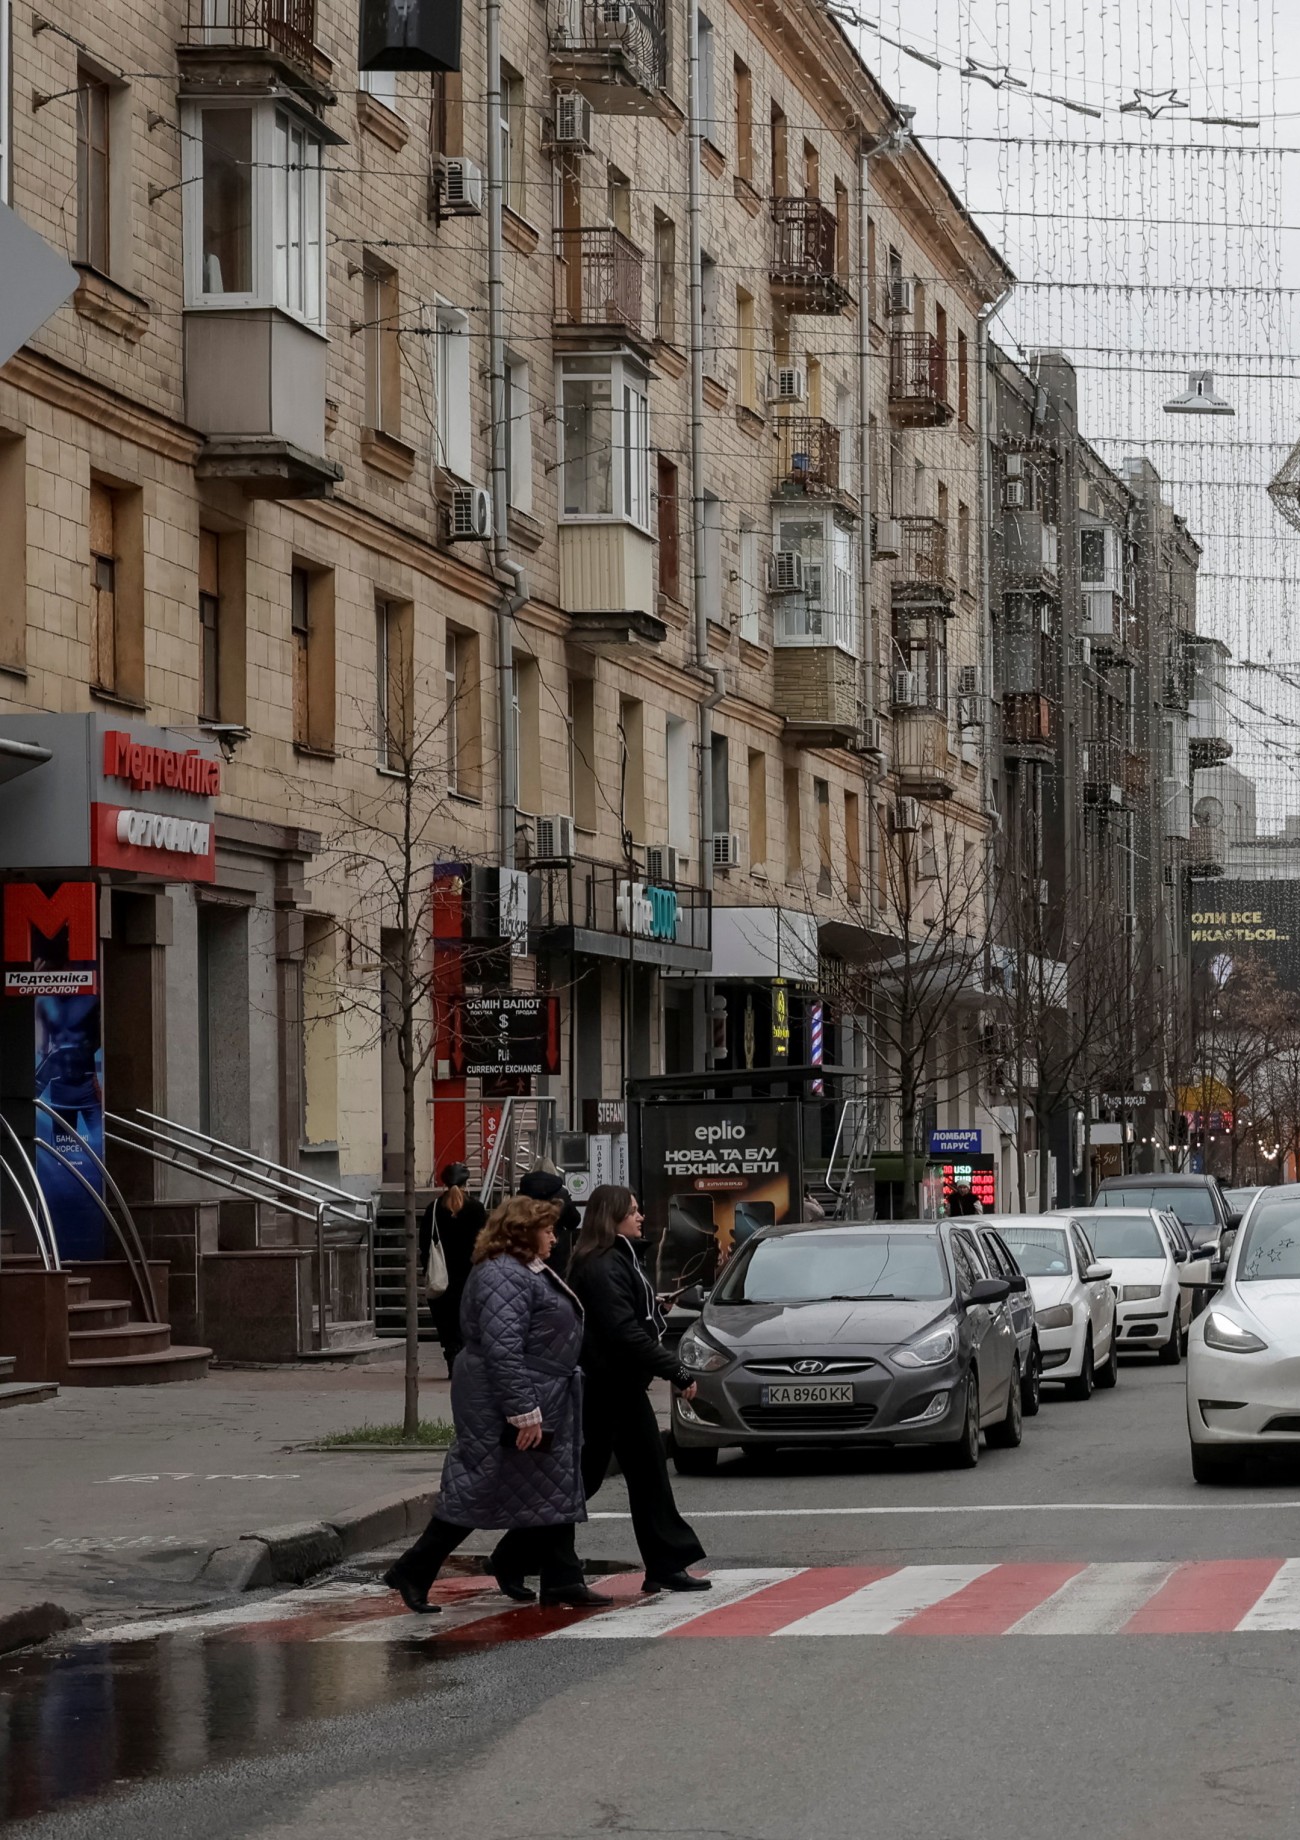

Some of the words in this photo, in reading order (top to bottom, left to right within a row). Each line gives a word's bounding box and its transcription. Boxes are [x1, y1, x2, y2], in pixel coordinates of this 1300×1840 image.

[104, 730, 220, 796] Медтехніка
[1231, 911, 1262, 924] ВСЕ
[8, 973, 89, 986] Медтехніка
[18, 986, 79, 995] ОРТОСАЛОН
[502, 999, 541, 1010] ВАЛЮТ
[499, 1013, 509, 1029] $
[466, 1064, 503, 1074] CURRENCY
[505, 1064, 542, 1073] EXCHANGE
[695, 1120, 745, 1144] eplio
[932, 1132, 977, 1142] ЛОМБАРД
[55, 1135, 89, 1144] БАНДЖІ
[940, 1142, 970, 1150] ПАРУС
[665, 1149, 717, 1162] НОВА
[719, 1148, 742, 1160] ТА
[745, 1147, 777, 1161] Б/У
[663, 1162, 739, 1175] ТЕХНІКА
[742, 1161, 779, 1174] ЕПЛ
[953, 1165, 972, 1174] USD
[770, 1388, 791, 1402] KA
[793, 1388, 828, 1402] 8960
[830, 1387, 851, 1401] KK
